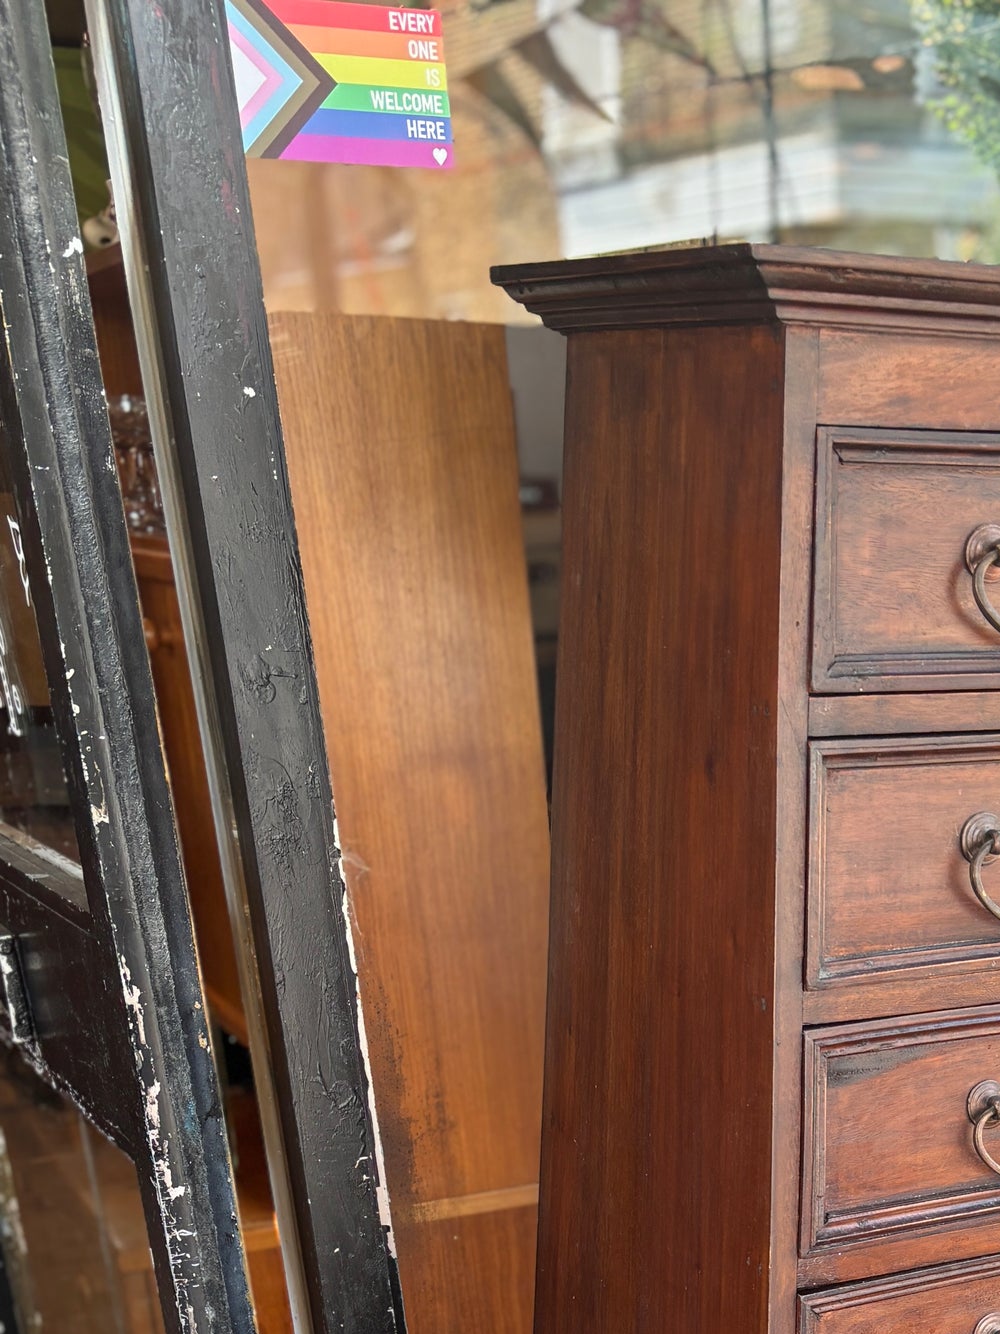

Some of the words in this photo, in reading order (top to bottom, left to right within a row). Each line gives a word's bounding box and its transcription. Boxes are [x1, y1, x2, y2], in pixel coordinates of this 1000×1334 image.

[388, 11, 435, 33] EVERY
[408, 40, 439, 60] ONE
[426, 69, 441, 87] IS
[370, 90, 443, 114] WELCOME
[407, 119, 446, 140] HERE
